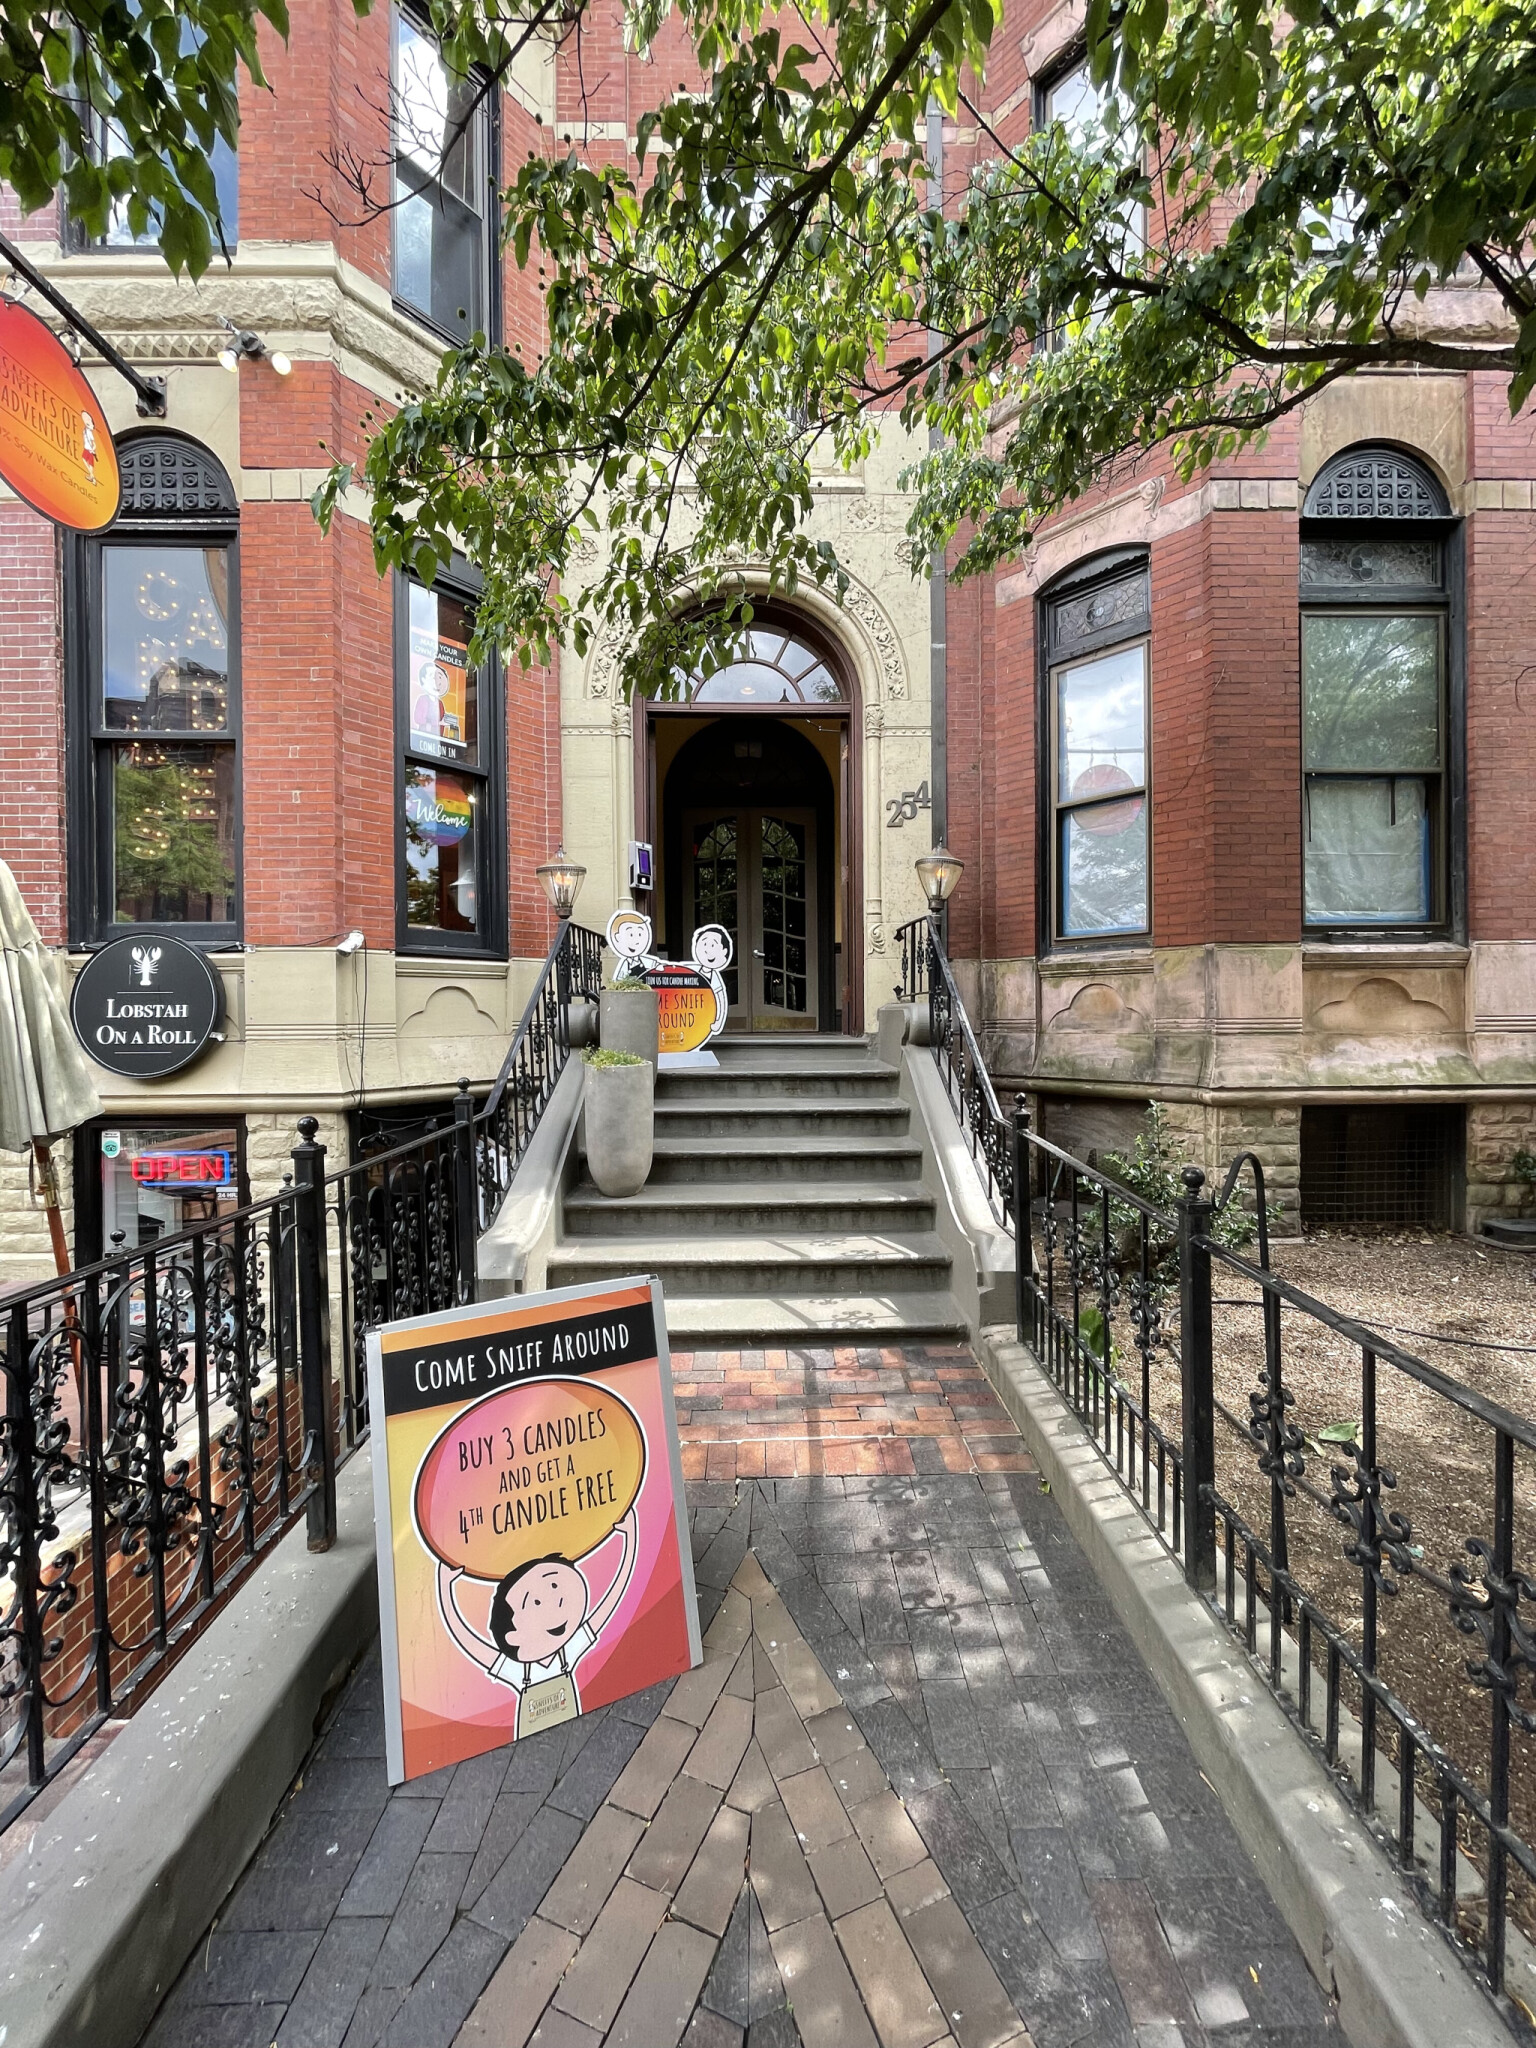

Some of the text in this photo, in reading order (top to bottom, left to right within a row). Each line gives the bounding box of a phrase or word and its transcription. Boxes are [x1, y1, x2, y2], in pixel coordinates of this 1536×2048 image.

[2, 356, 79, 434] SNIFFS OF
[2, 384, 79, 461] ADVENTURE
[14, 436, 34, 459] Soy
[36, 452, 58, 475] Wax
[60, 470, 98, 505] Candles
[439, 644, 458, 656] YOUR
[419, 739, 436, 753] COME
[437, 743, 447, 757] ON
[412, 799, 469, 828] Welcome
[885, 781, 932, 828] 254
[106, 998, 188, 1019] LOBSTAH
[658, 1012, 695, 1029] ROUND
[674, 993, 704, 1010] SNIFF
[130, 1156, 224, 1181] OPEN
[414, 1323, 630, 1392] COME SNIFF AROUND
[458, 1408, 607, 1472] BUY 3 CANDLES
[499, 1454, 575, 1495] AND GET A
[458, 1469, 617, 1544] 4TH CANDLE FREE
